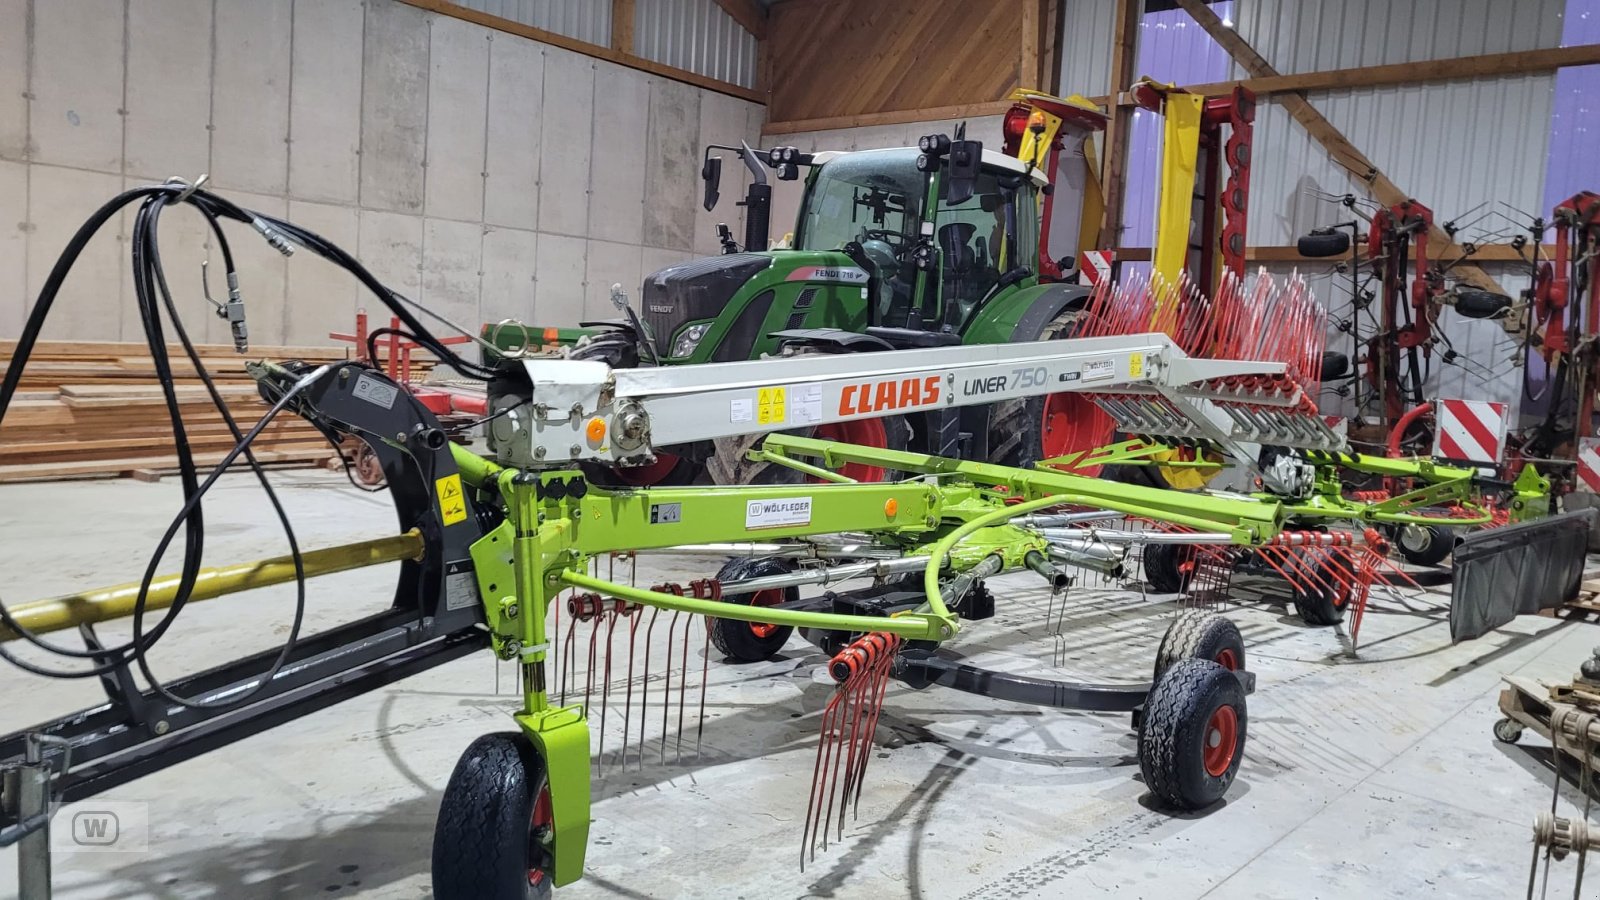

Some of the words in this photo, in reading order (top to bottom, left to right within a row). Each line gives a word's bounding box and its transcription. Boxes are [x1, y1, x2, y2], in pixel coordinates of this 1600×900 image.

[815, 269, 840, 278] FENDT
[650, 304, 674, 314] FENDT
[963, 375, 1007, 396] LINER
[1010, 366, 1048, 390] 750
[838, 376, 941, 416] CLAAS
[763, 502, 809, 513] WÖLFLEDER
